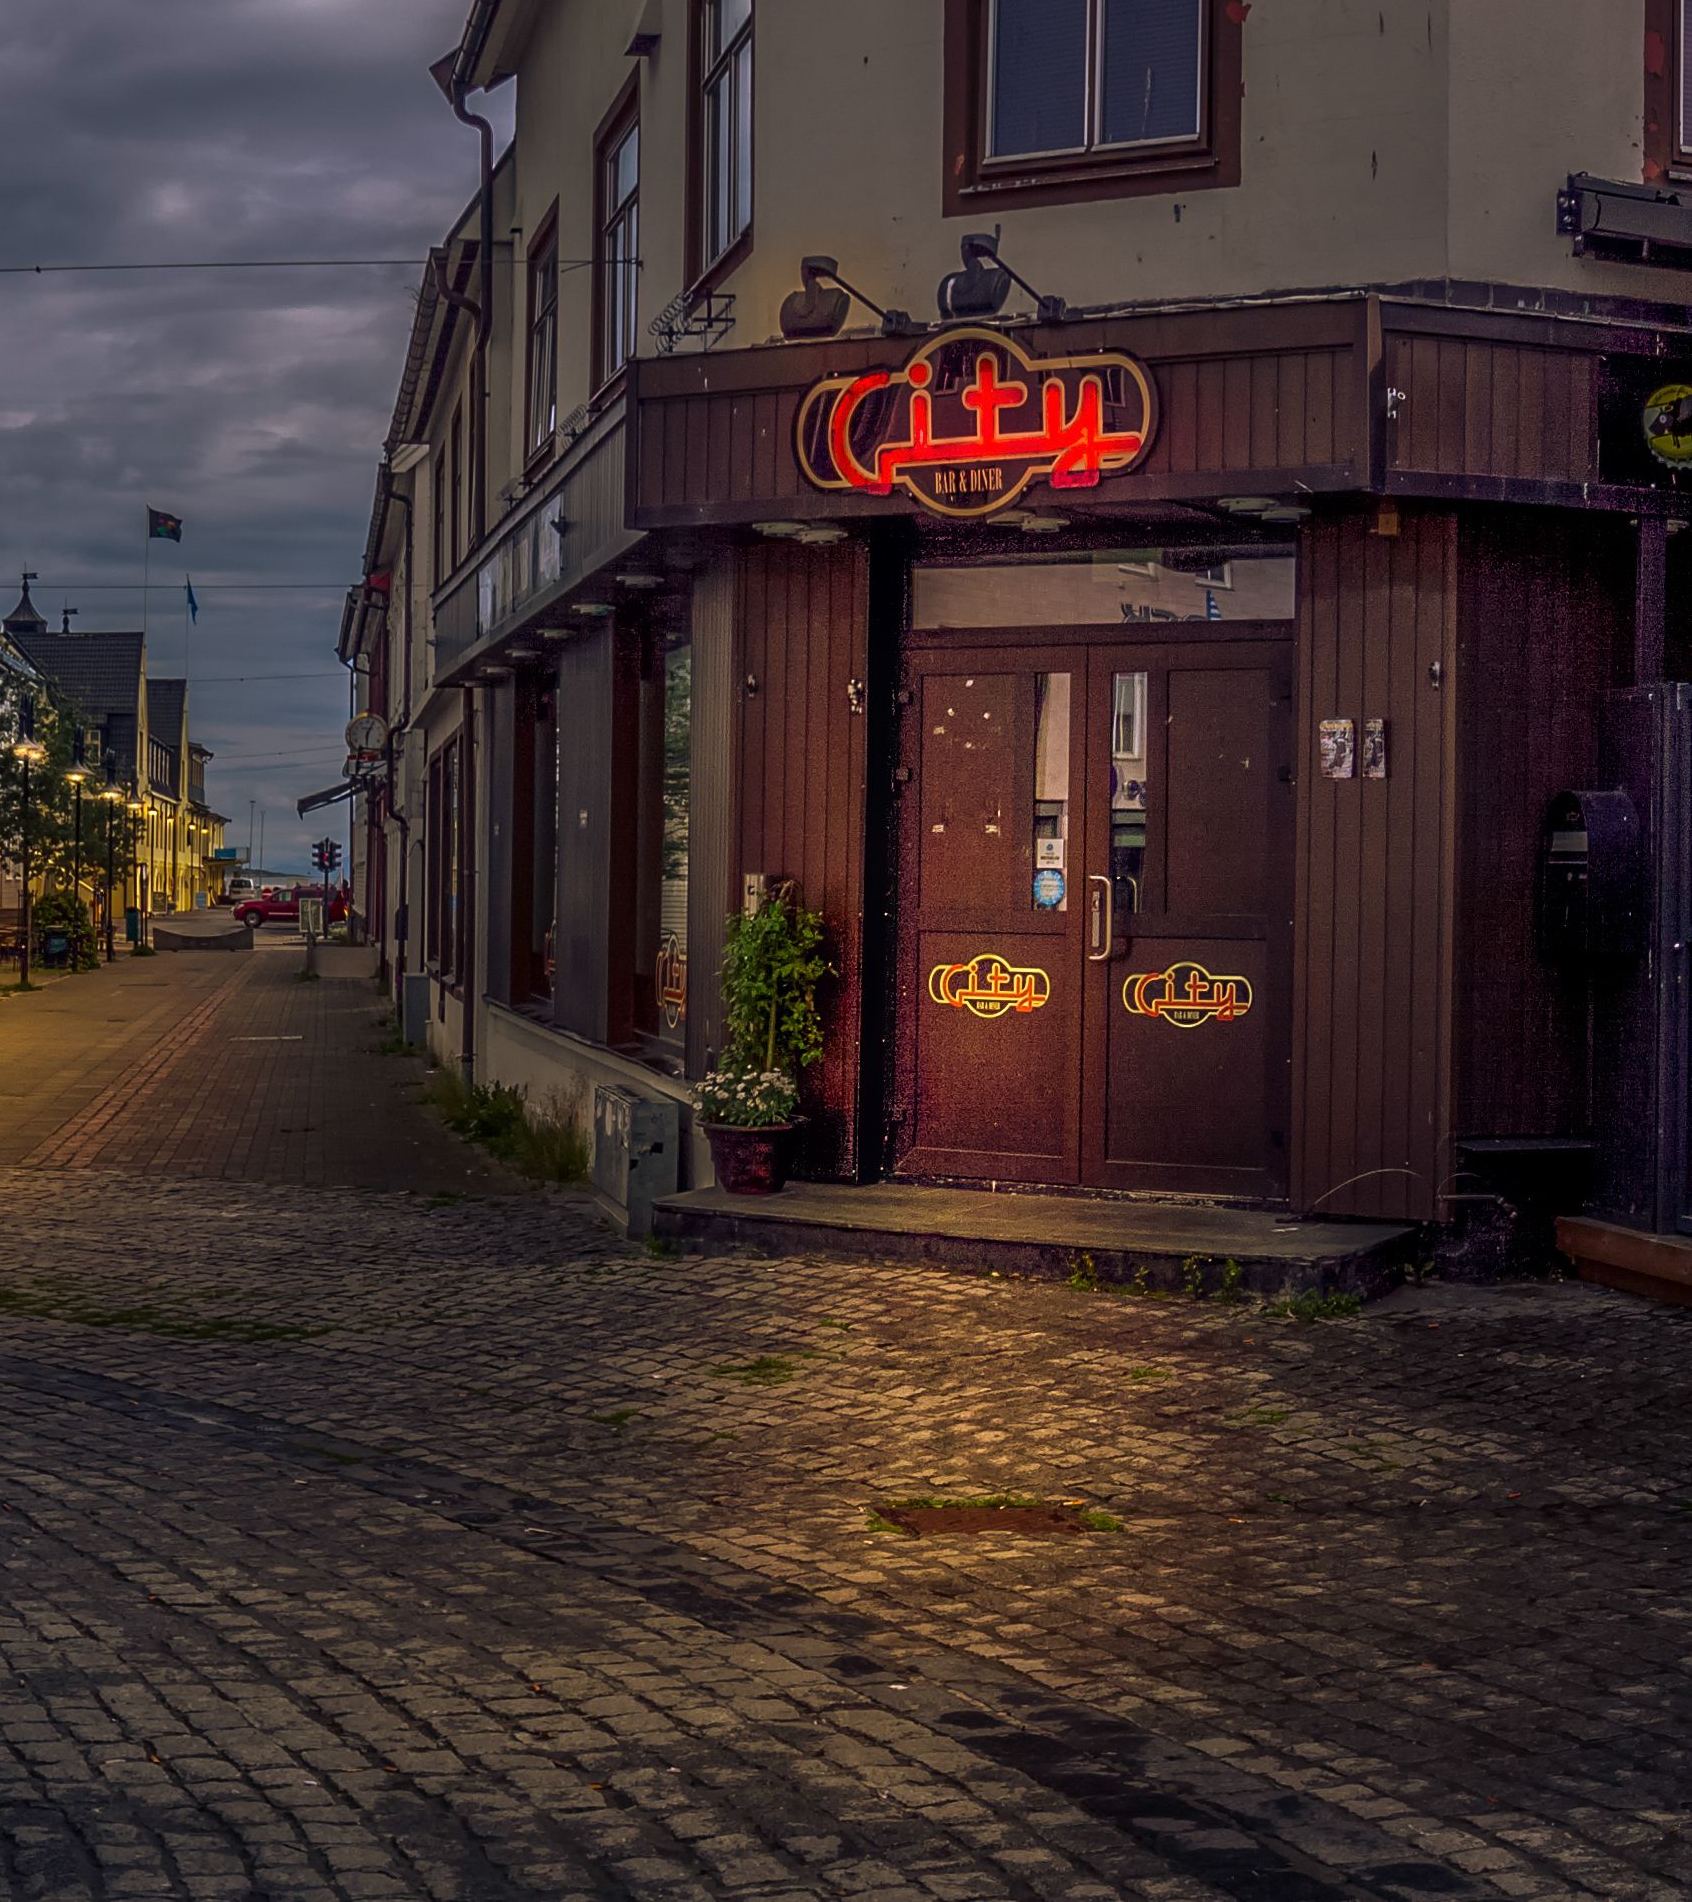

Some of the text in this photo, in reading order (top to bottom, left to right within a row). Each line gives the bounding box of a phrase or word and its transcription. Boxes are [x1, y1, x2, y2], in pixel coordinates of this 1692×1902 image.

[829, 352, 1142, 495] City
[935, 468, 1003, 494] BAR & DINER
[940, 962, 1047, 1012] City
[1135, 970, 1249, 1021] City
